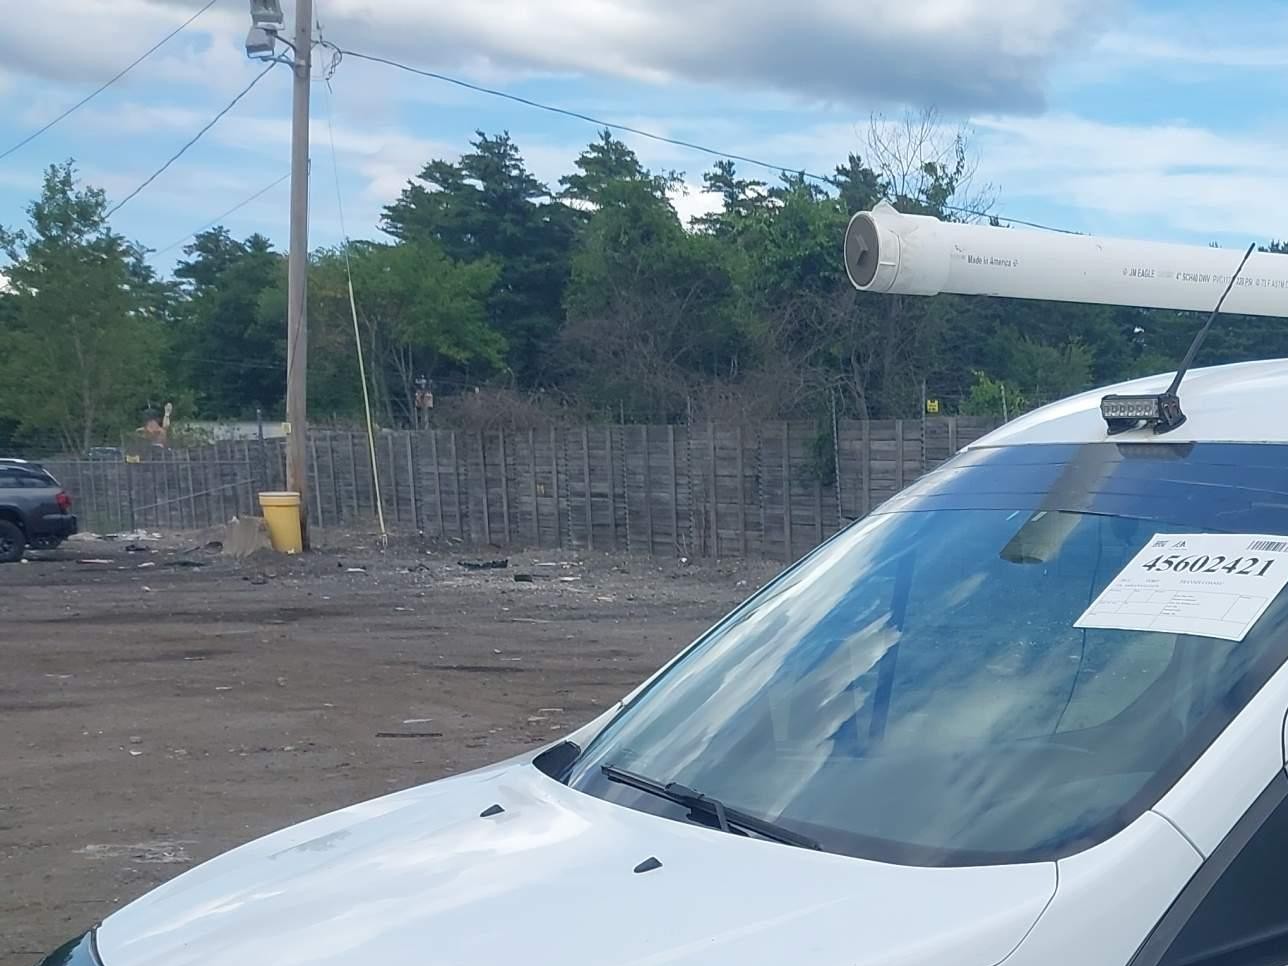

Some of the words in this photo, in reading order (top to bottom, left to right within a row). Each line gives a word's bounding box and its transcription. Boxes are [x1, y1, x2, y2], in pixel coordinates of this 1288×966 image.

[968, 255, 982, 264] Made
[990, 256, 1011, 267] America
[1137, 269, 1155, 278] EAGLE
[1142, 554, 1275, 577] 45602421
